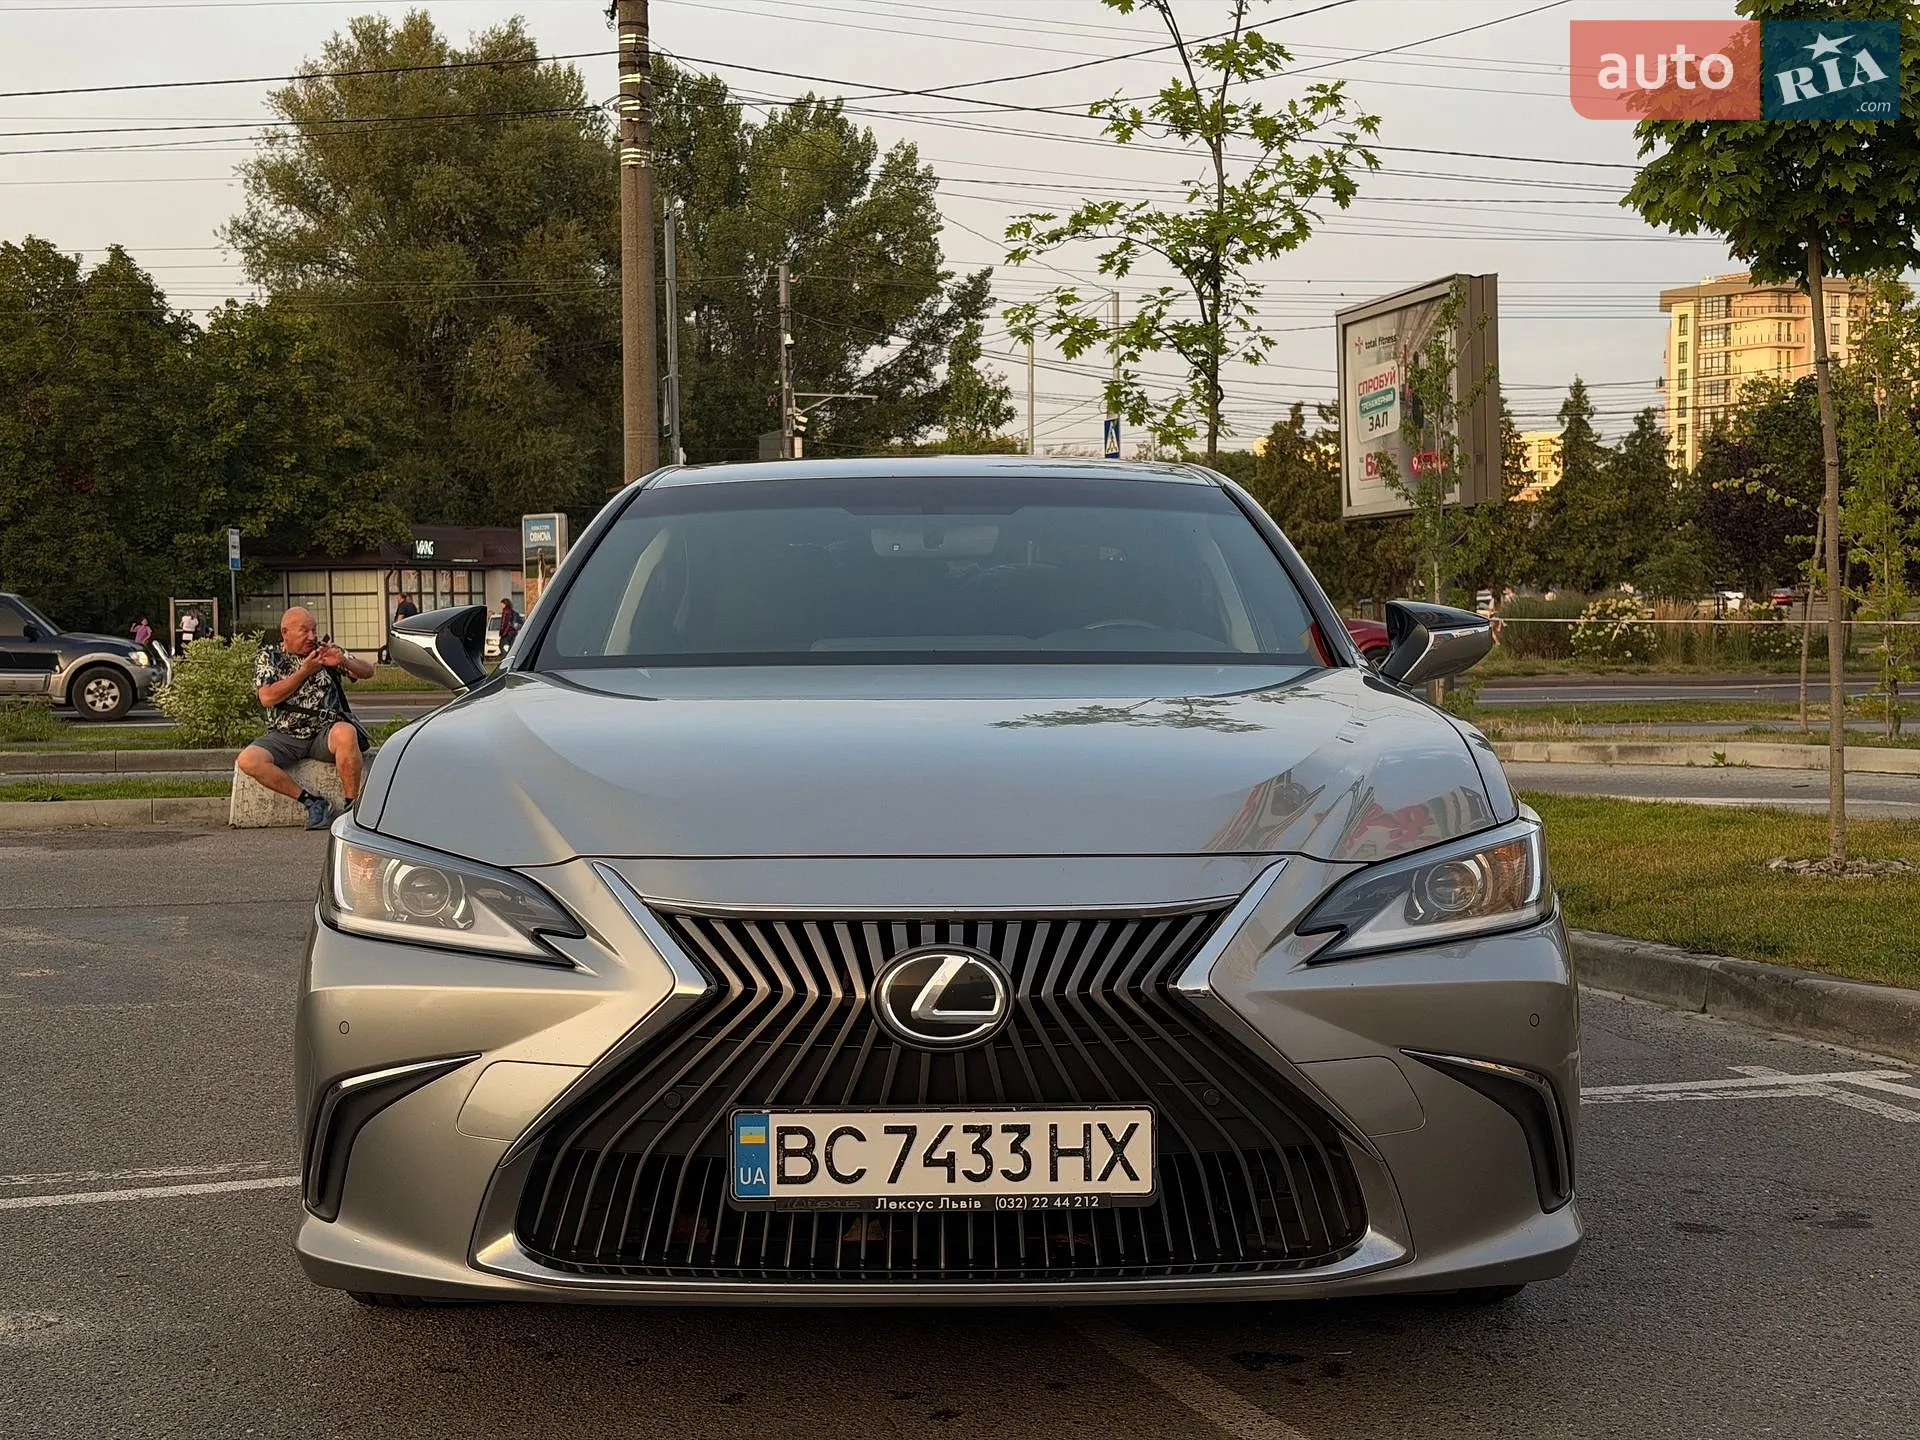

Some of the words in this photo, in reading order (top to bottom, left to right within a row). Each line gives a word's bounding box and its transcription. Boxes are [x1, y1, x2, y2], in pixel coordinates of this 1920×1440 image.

[1358, 367, 1396, 397] СПРОБУЙ
[1368, 411, 1388, 432] ЗАЛ
[776, 1125, 867, 1185] BC
[883, 1123, 1032, 1184] 7433
[1048, 1122, 1140, 1182] HX
[739, 1167, 767, 1185] UA
[875, 1197, 934, 1213] Лексус
[938, 1197, 982, 1209] Львів
[995, 1196, 1028, 1211] (032)
[1031, 1197, 1049, 1208] 22
[1053, 1196, 1070, 1208] 44
[1074, 1196, 1099, 1207] 212
